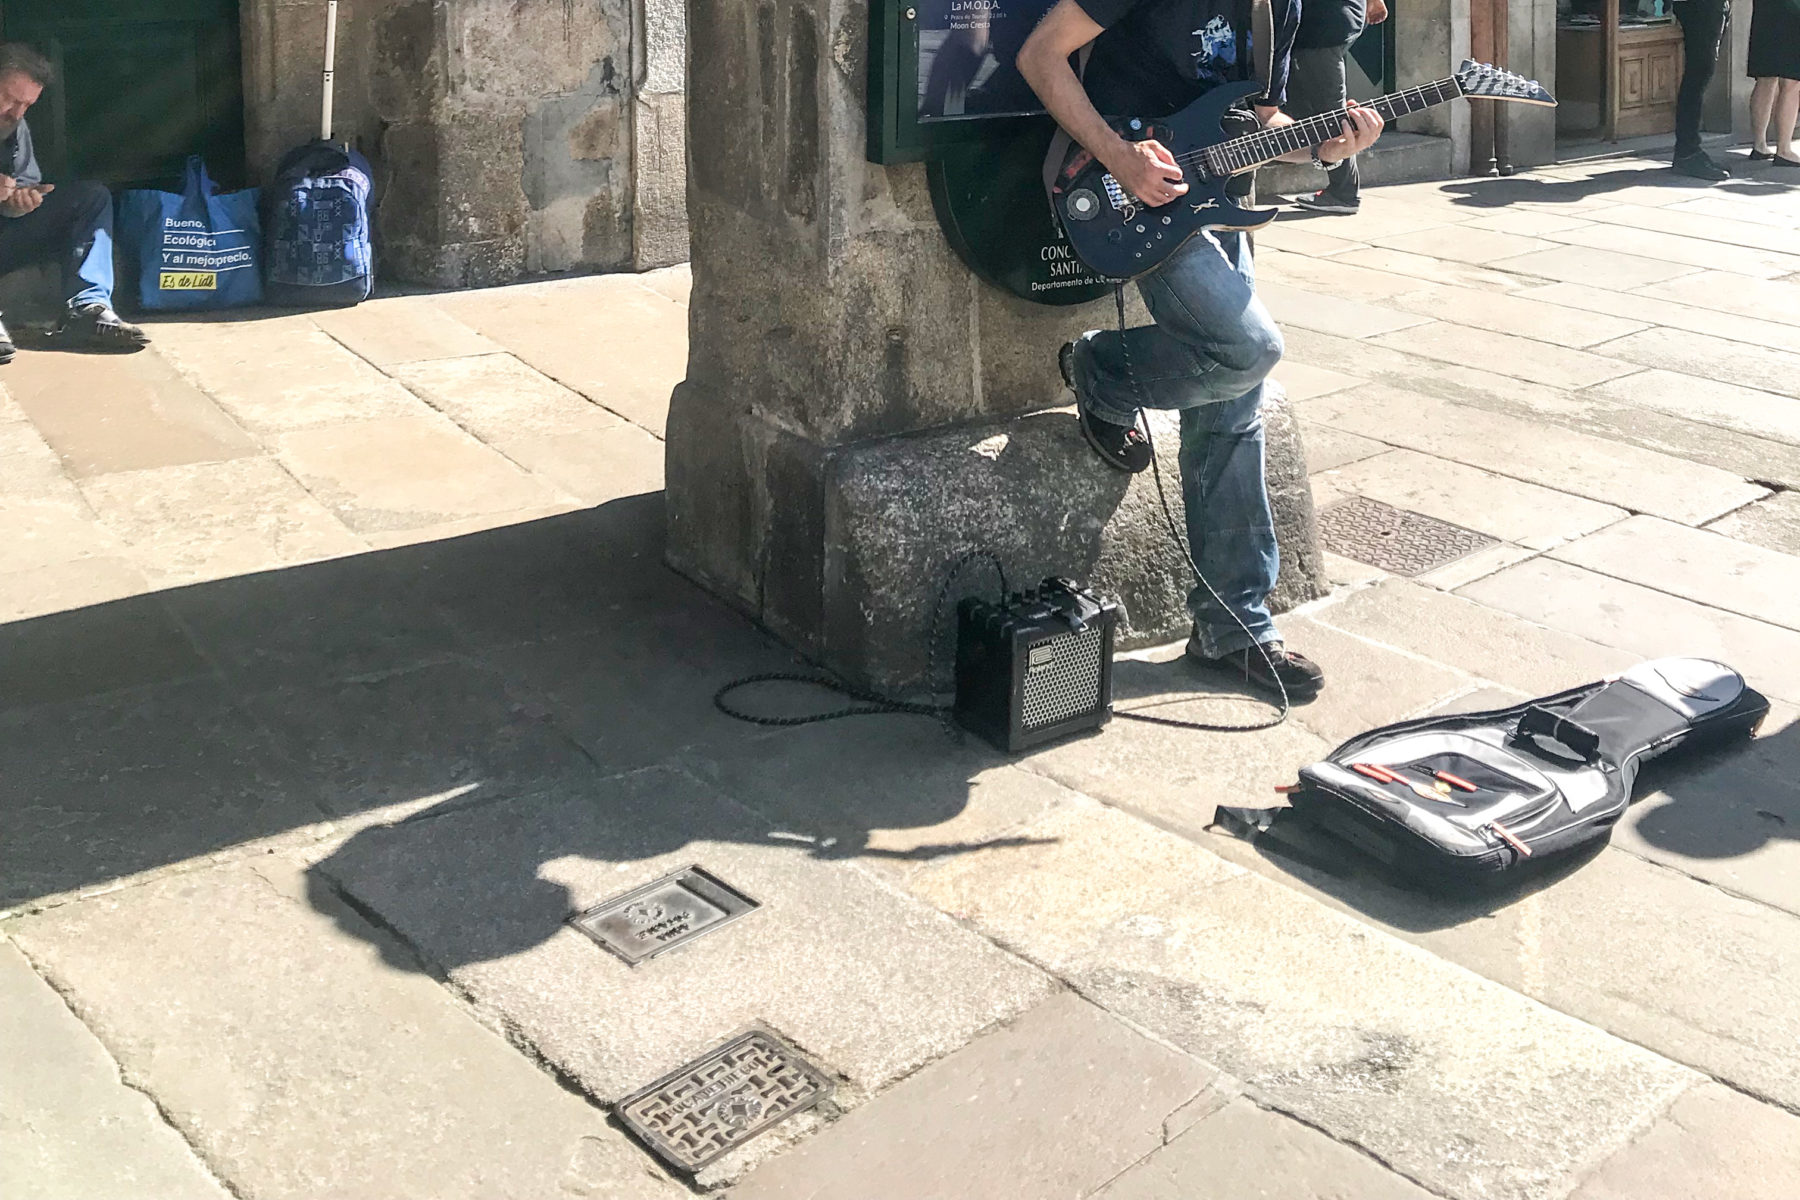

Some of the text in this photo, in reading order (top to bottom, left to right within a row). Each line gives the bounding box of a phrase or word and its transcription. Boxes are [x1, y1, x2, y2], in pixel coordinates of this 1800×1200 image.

[951, 1, 962, 11] La
[950, 21, 991, 30] Moon Cresta
[165, 217, 206, 228] Bueno.
[162, 251, 252, 267] Y al mejo precio.
[1041, 245, 1072, 261] CONC
[162, 274, 214, 289] Es de Lidl
[1032, 278, 1083, 291] Departamento
[1084, 276, 1094, 285] de
